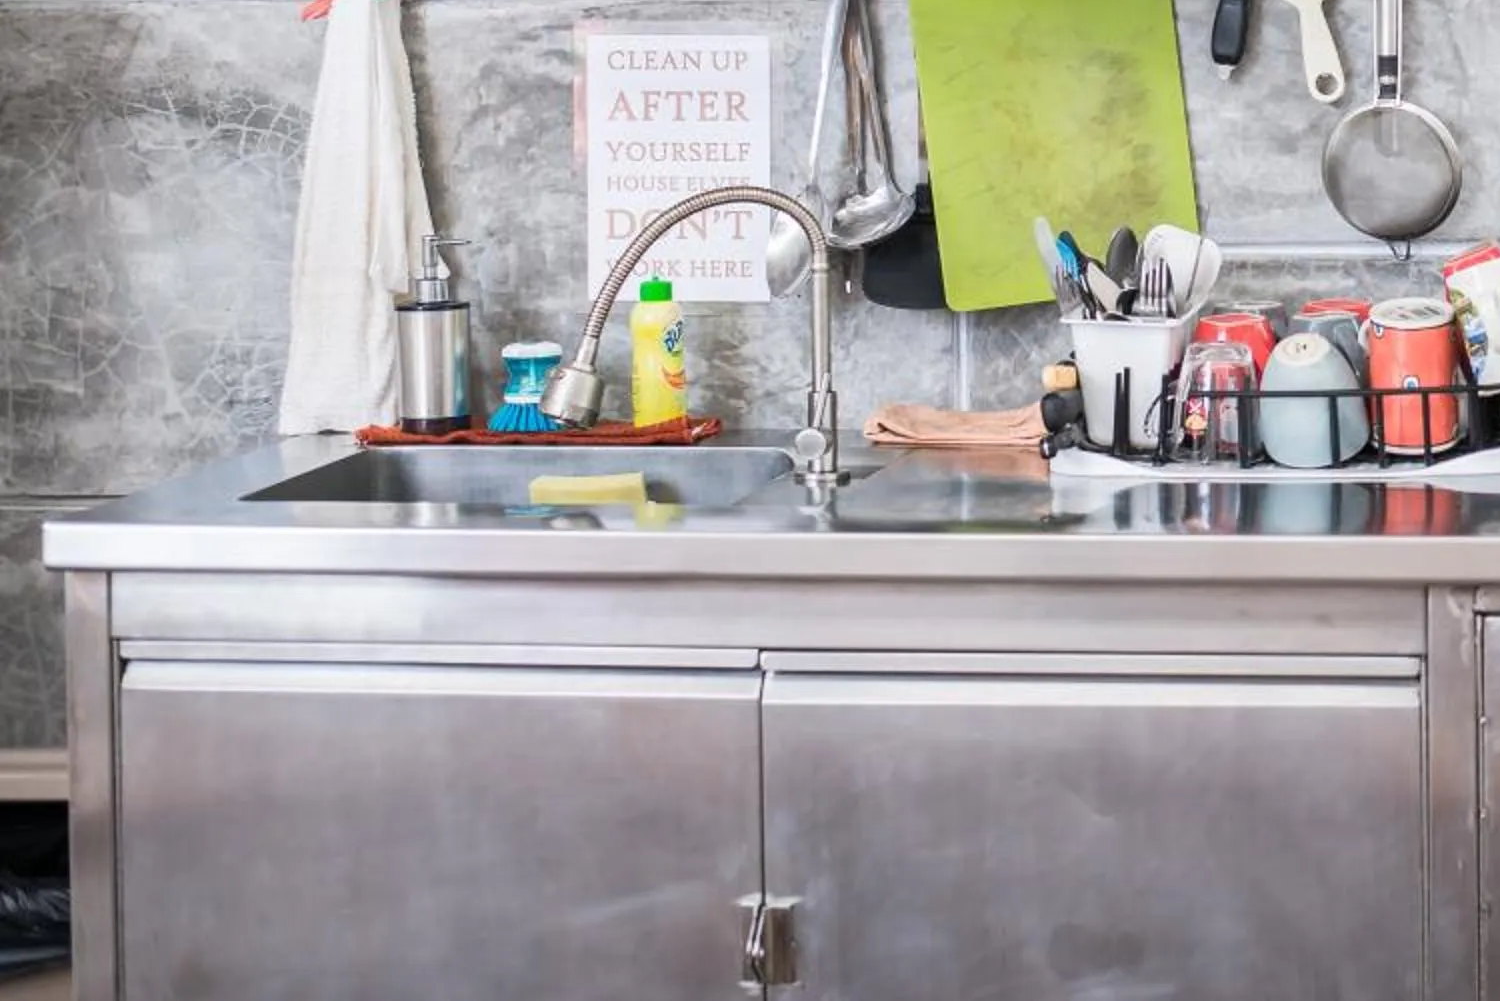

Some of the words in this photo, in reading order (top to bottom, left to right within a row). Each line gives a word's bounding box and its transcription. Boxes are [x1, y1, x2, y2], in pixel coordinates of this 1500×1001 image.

[608, 50, 702, 71] CLEAN
[711, 50, 748, 71] UP
[607, 90, 750, 122] AFTER
[605, 142, 751, 162] YOURSELF
[607, 176, 680, 192] HOUSE
[606, 259, 683, 278] ORK
[690, 260, 753, 278] HERE
